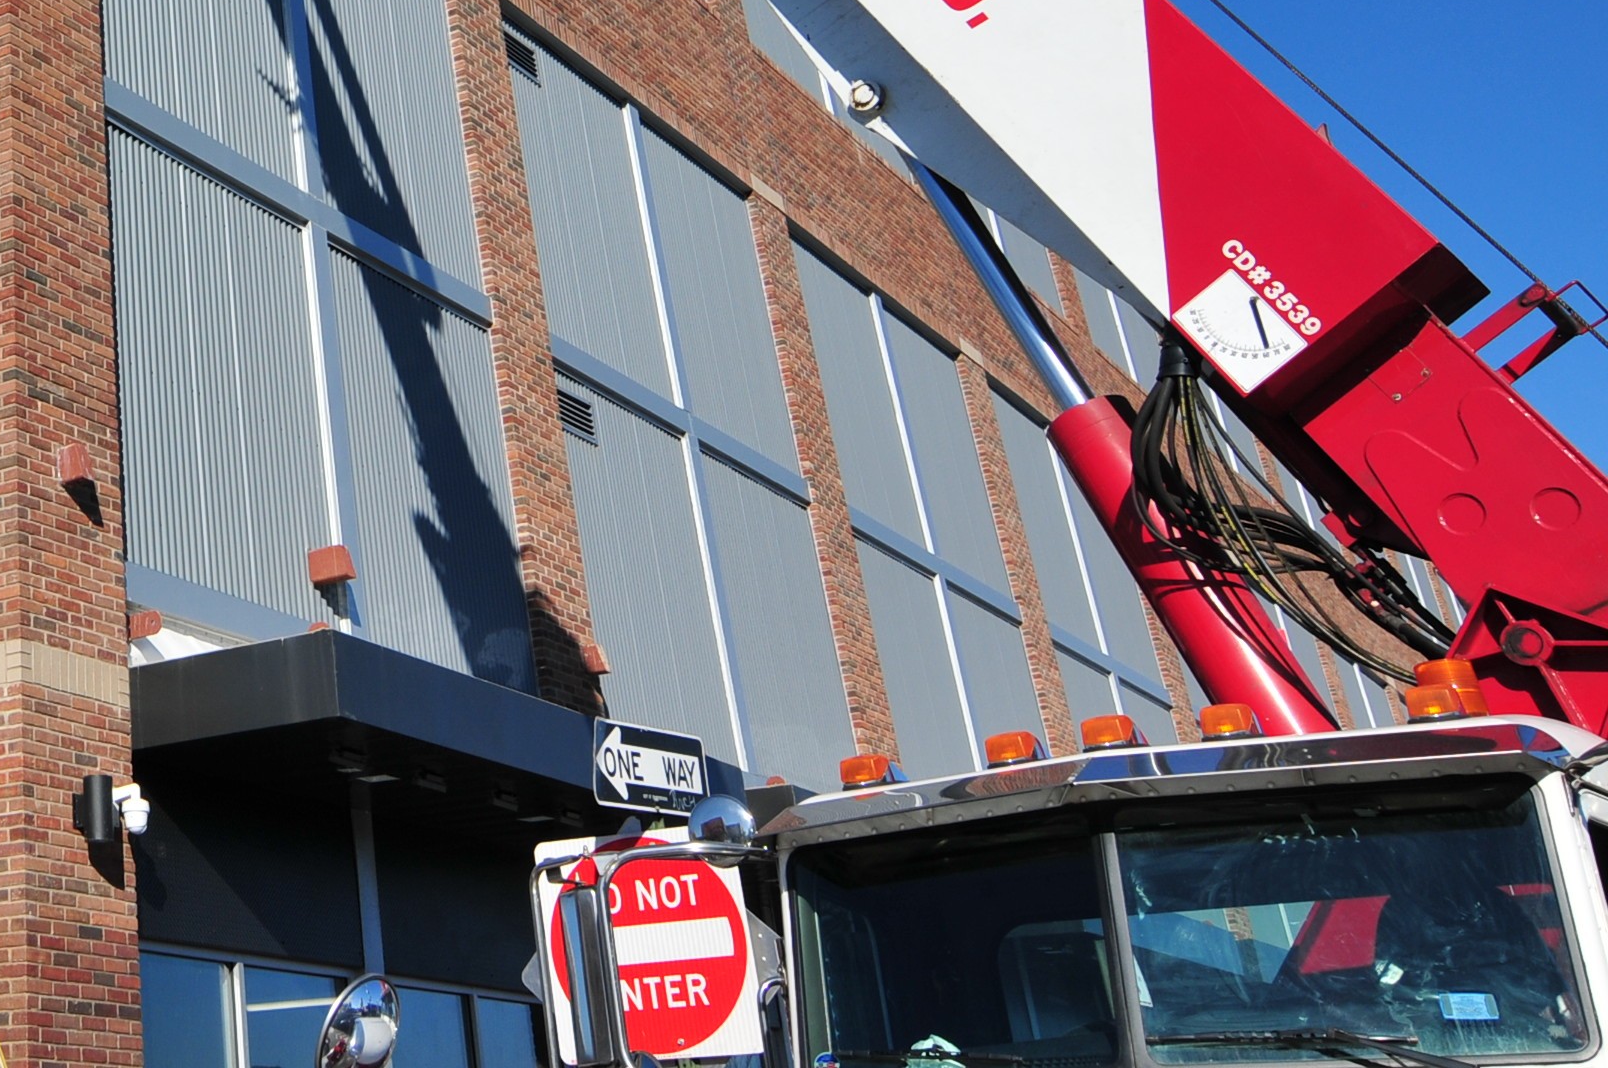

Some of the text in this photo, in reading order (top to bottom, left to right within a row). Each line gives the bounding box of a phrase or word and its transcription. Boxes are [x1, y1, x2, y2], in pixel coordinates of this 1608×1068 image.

[1221, 238, 1322, 336] CD#3539
[603, 746, 696, 790] ONE WAY
[634, 873, 700, 912] NOT
[620, 972, 711, 1013] NTER
